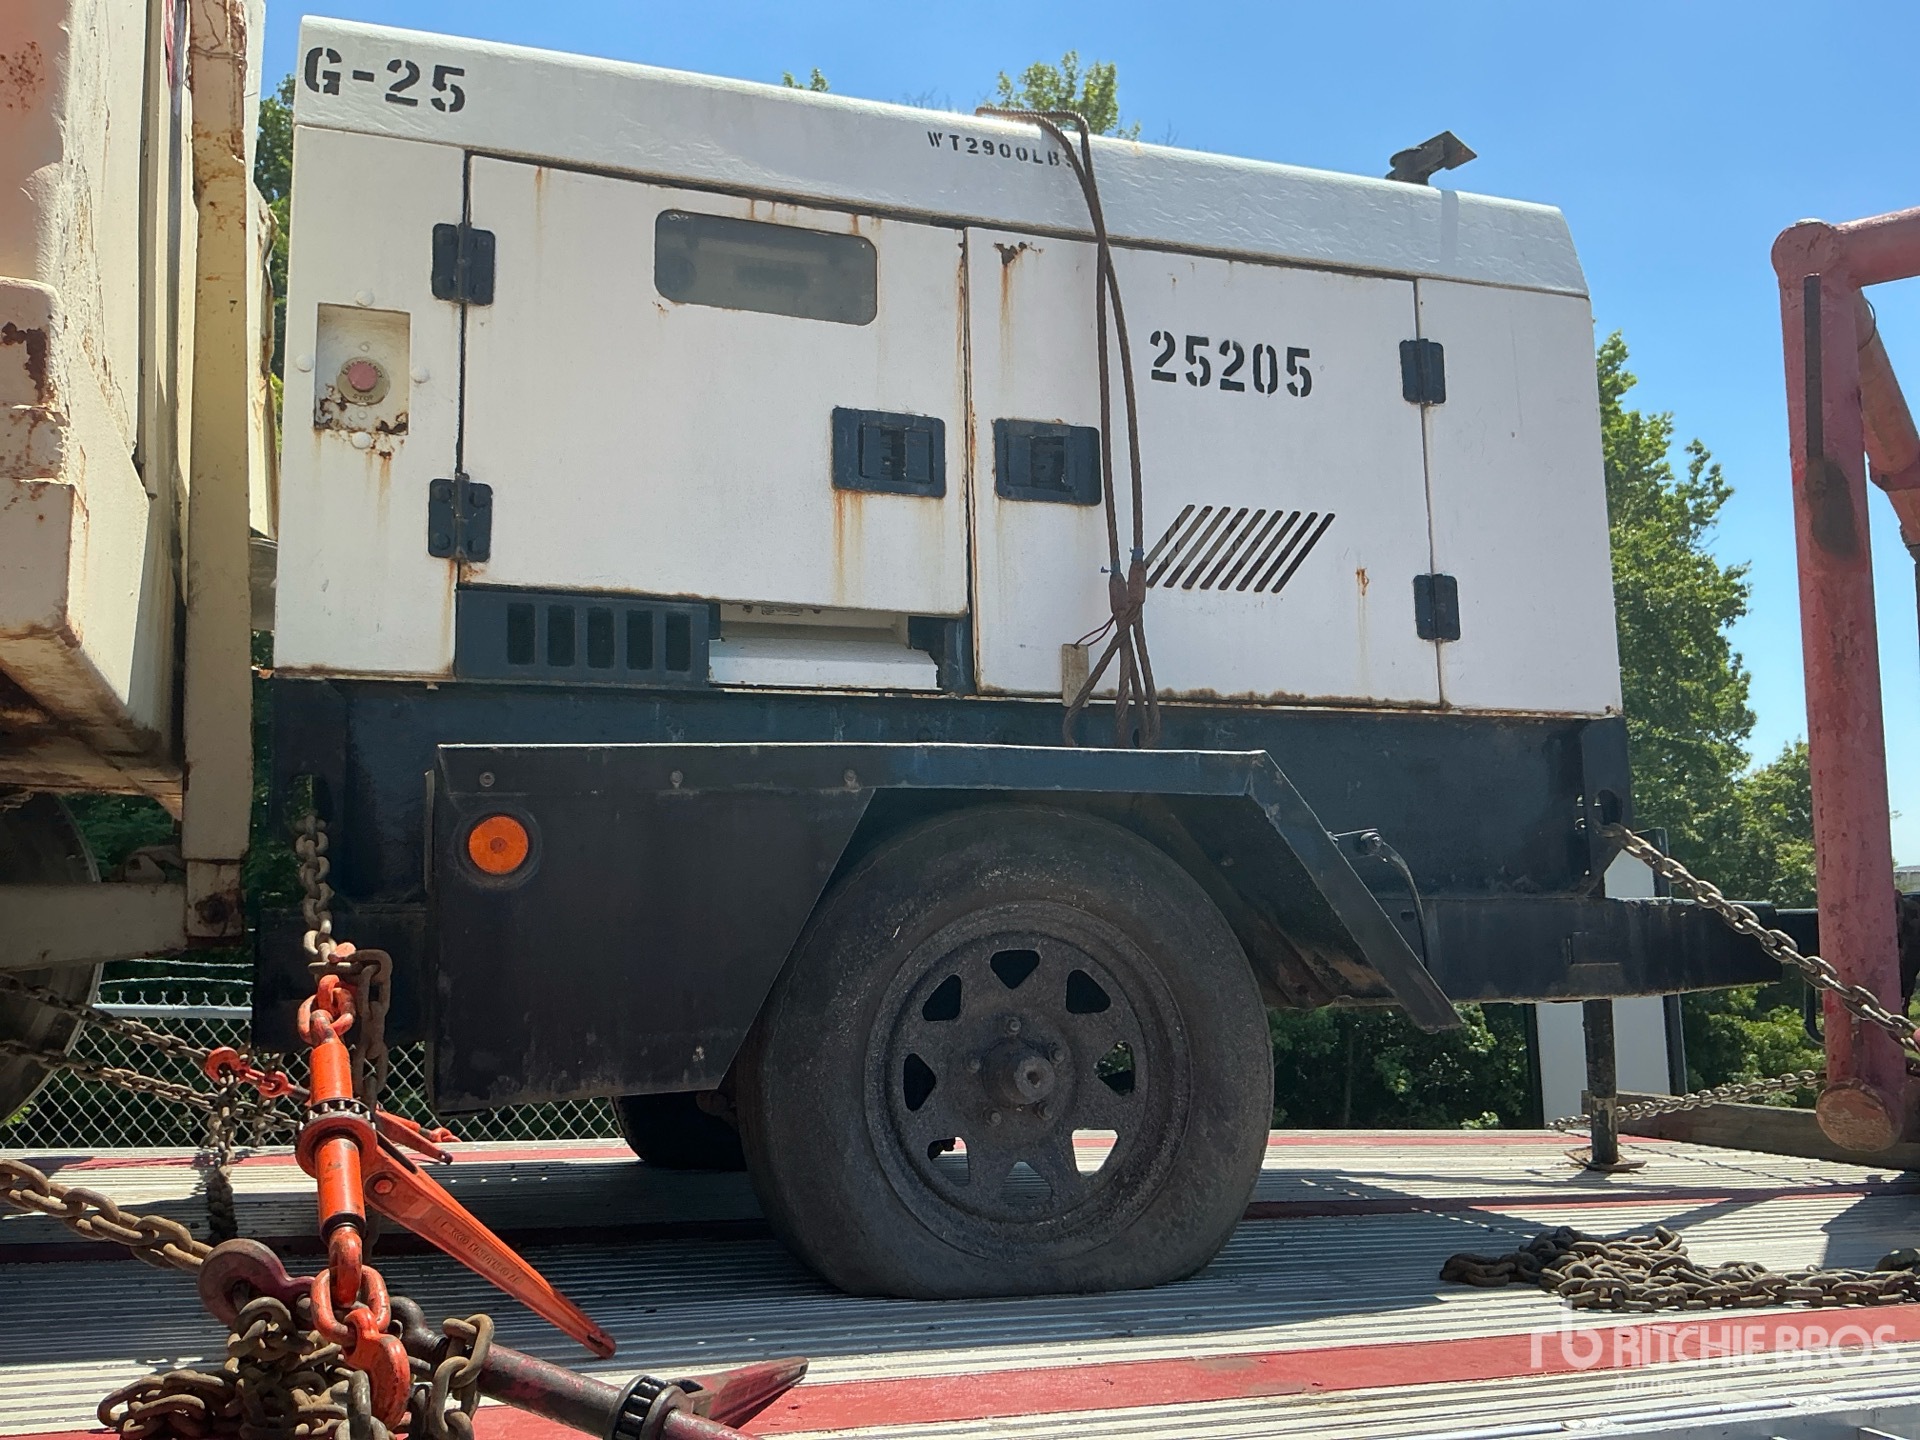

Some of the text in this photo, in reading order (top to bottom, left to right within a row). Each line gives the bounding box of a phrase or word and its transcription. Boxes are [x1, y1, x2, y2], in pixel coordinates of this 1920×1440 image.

[304, 47, 465, 112] G-25
[1149, 330, 1312, 397] 25205
[352, 393, 374, 401] STOP
